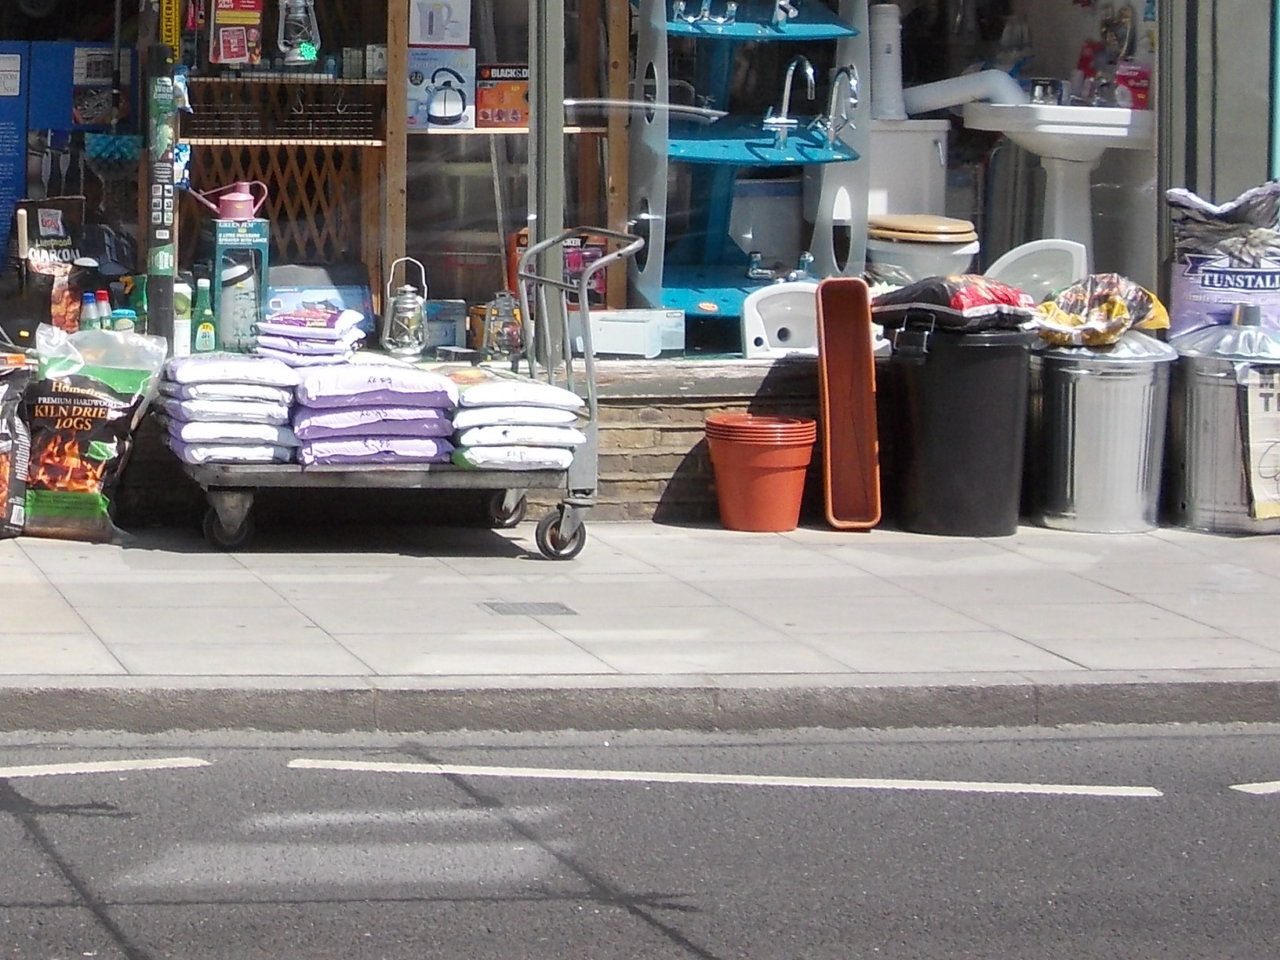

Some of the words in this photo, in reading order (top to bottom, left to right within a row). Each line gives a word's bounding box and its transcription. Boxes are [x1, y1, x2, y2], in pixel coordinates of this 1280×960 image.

[37, 396, 72, 405] PREMIUM
[34, 405, 69, 418] KILN
[71, 406, 110, 419] DRIE
[54, 417, 93, 431] LOGS
